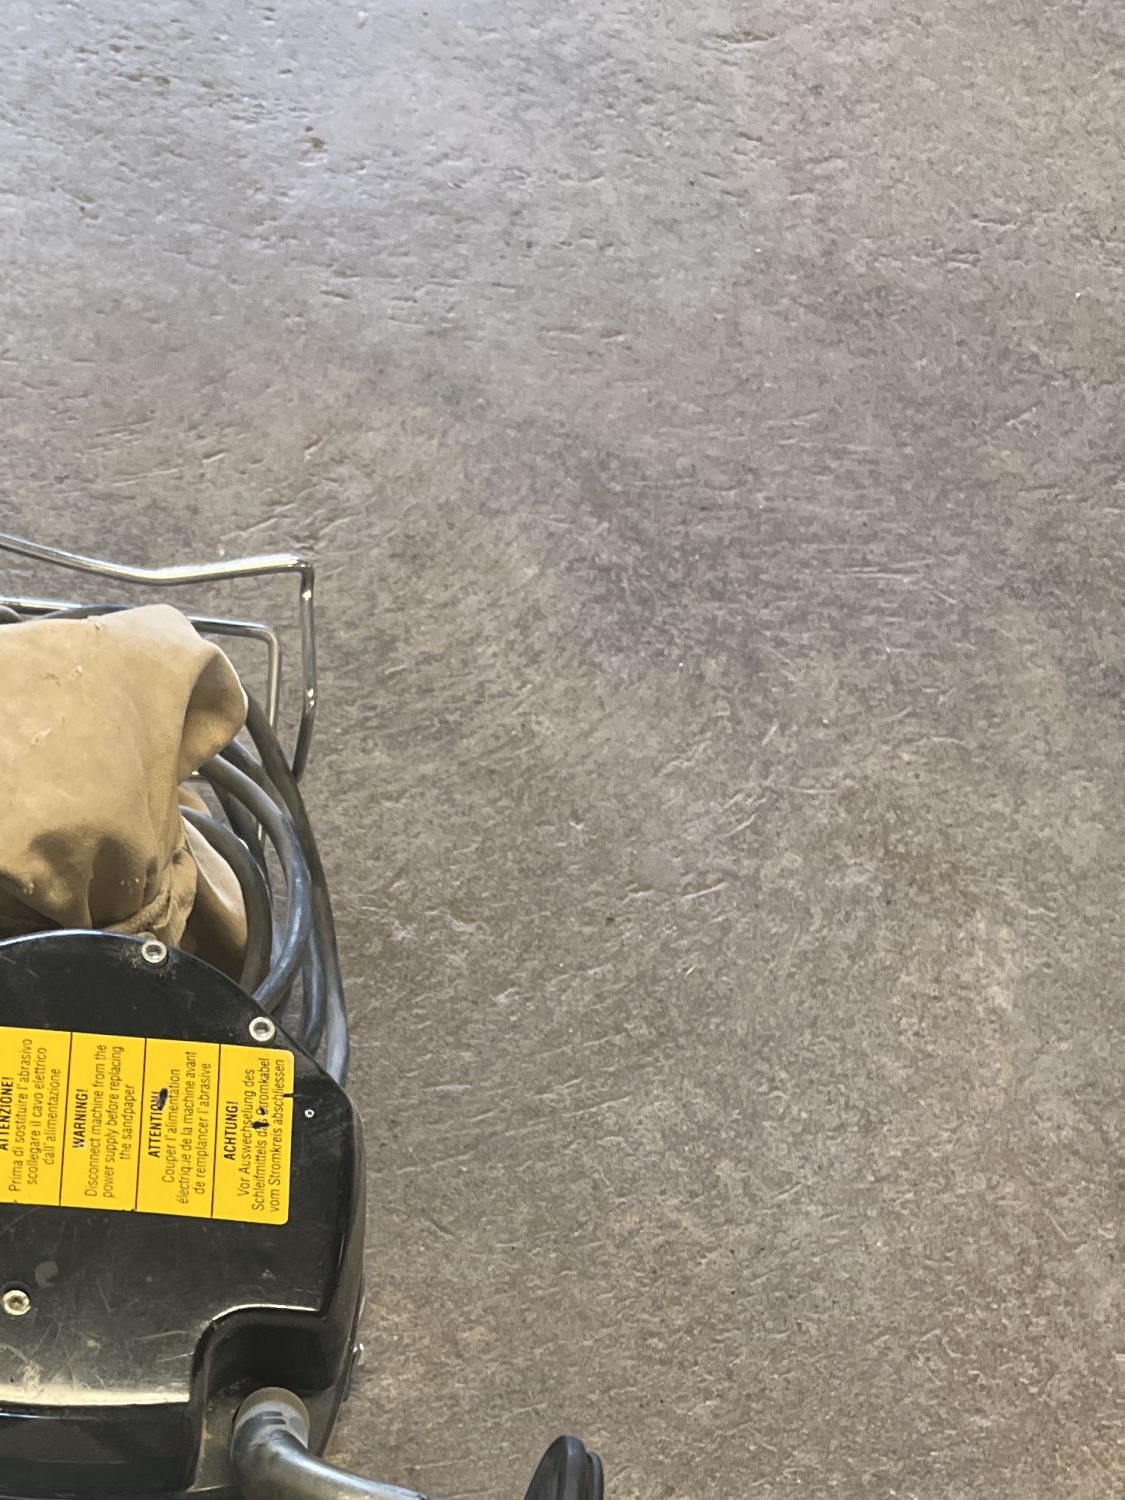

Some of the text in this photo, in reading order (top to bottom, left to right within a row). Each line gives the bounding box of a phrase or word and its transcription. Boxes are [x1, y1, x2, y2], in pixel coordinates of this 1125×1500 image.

[33, 1047, 47, 1089] elettrico
[14, 1093, 28, 1143] sostituire
[32, 1092, 44, 1118] cavo
[72, 1088, 88, 1148] WARNING!
[84, 1044, 107, 1197] Disconnect machine from the
[103, 1046, 125, 1198] power supply before replacing
[119, 1084, 137, 1160] the sandpaper
[176, 1051, 197, 1205] électrique de la machine avant
[223, 1101, 238, 1161] ACHTUNG!
[237, 1069, 256, 1196] Vor Auswechselung des
[12, 1146, 24, 1157] di
[26, 1130, 42, 1185] scollegare
[161, 1144, 178, 1183] Couper
[195, 1118, 209, 1178] remplancer
[268, 1059, 285, 1213] vom Stromkreis abschliessen
[8, 1160, 23, 1192] Prima
[193, 1181, 205, 1195] de
[251, 1140, 267, 1212] Schleifmittels
